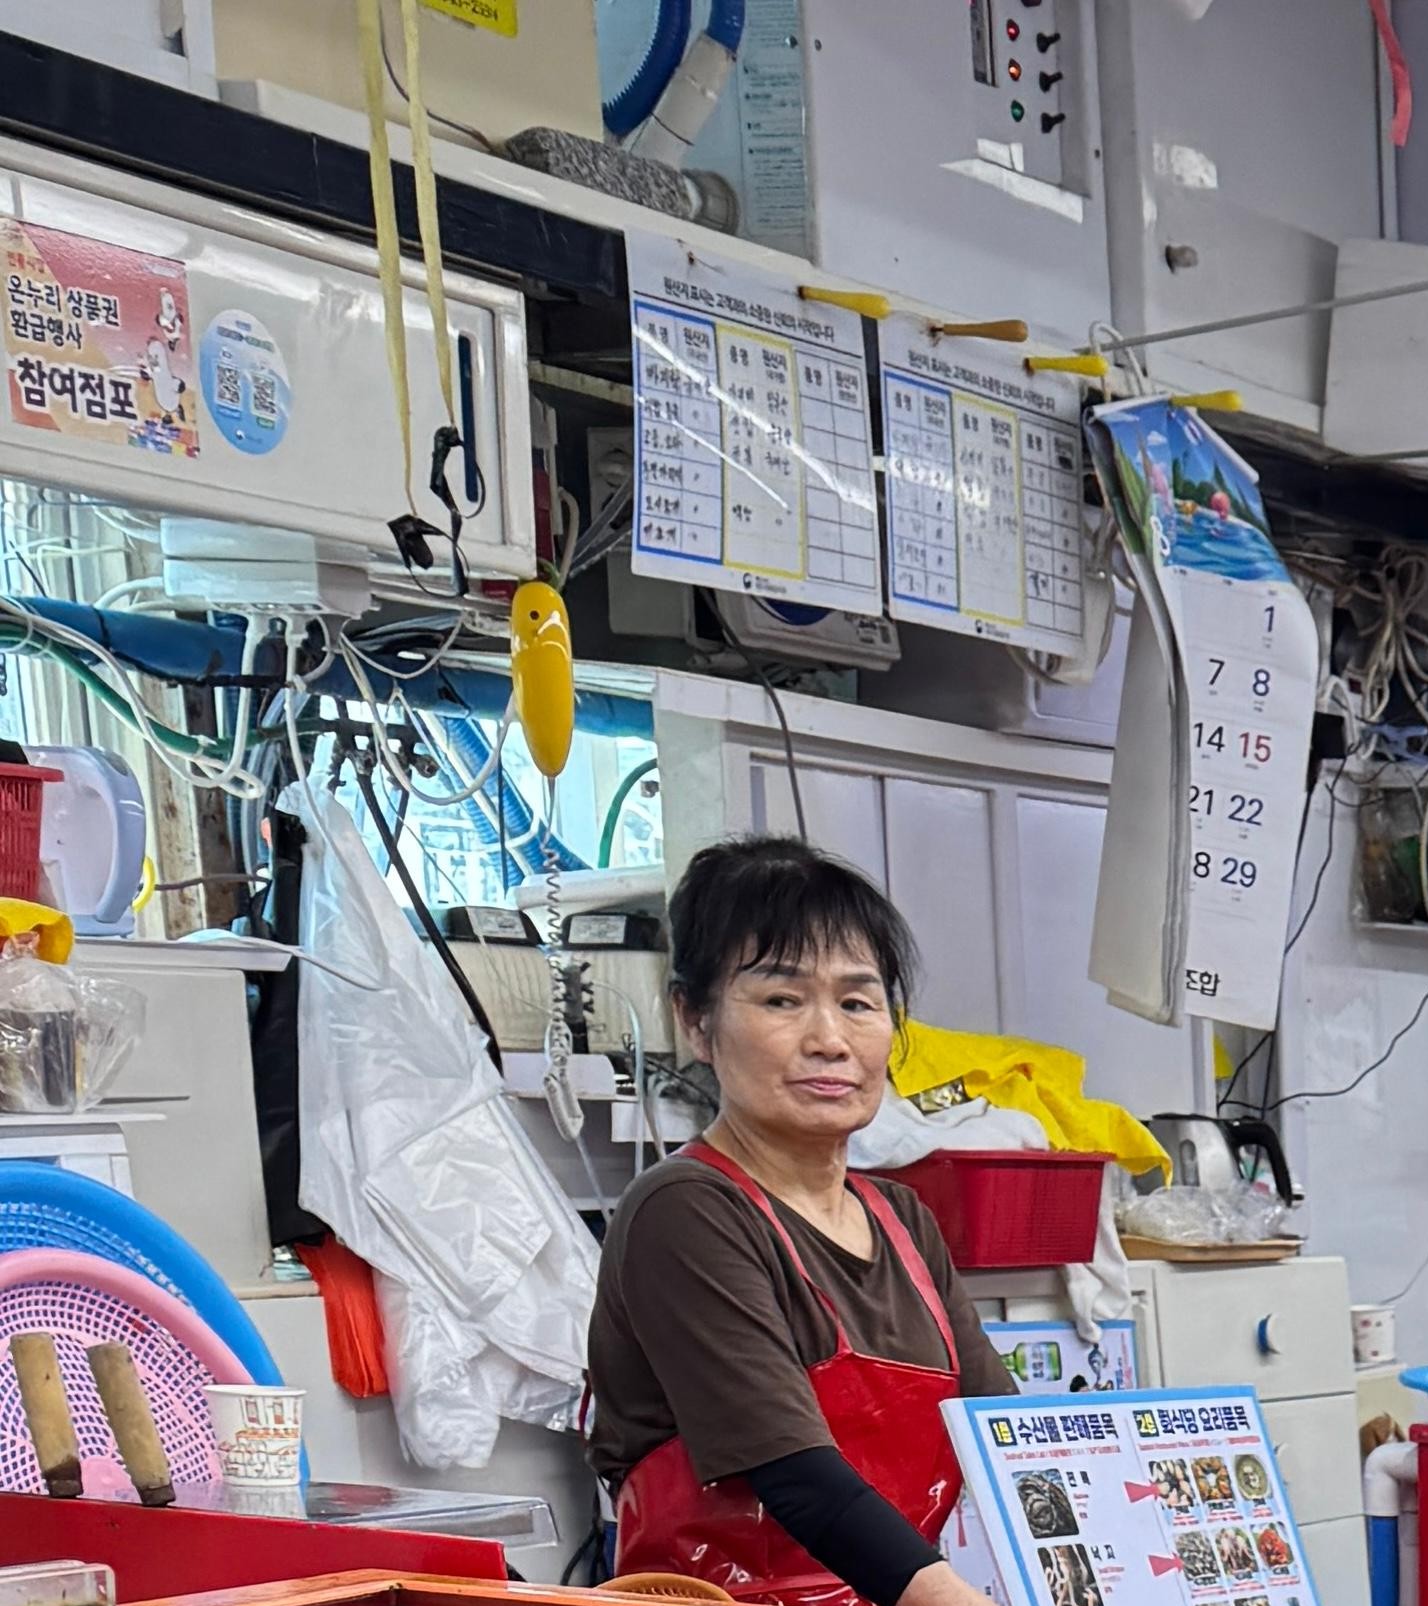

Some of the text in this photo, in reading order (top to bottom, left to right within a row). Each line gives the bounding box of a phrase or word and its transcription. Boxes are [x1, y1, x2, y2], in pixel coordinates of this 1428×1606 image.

[8, 274, 120, 327] 온누리 상품권
[10, 309, 83, 350] 환급행사
[683, 327, 710, 350] 원산지
[16, 357, 138, 421] 참여점포
[1264, 605, 1275, 633] 1
[1208, 658, 1271, 697] 7 8
[1193, 722, 1273, 763] 14 15
[1188, 785, 1265, 827] 21 22
[1193, 851, 1258, 889] 8 29
[1018, 1415, 1062, 1444] 수산물
[1060, 1412, 1120, 1442] 판매품목
[1157, 1408, 1200, 1434] 회식당
[1198, 1405, 1251, 1432] 요리품목
